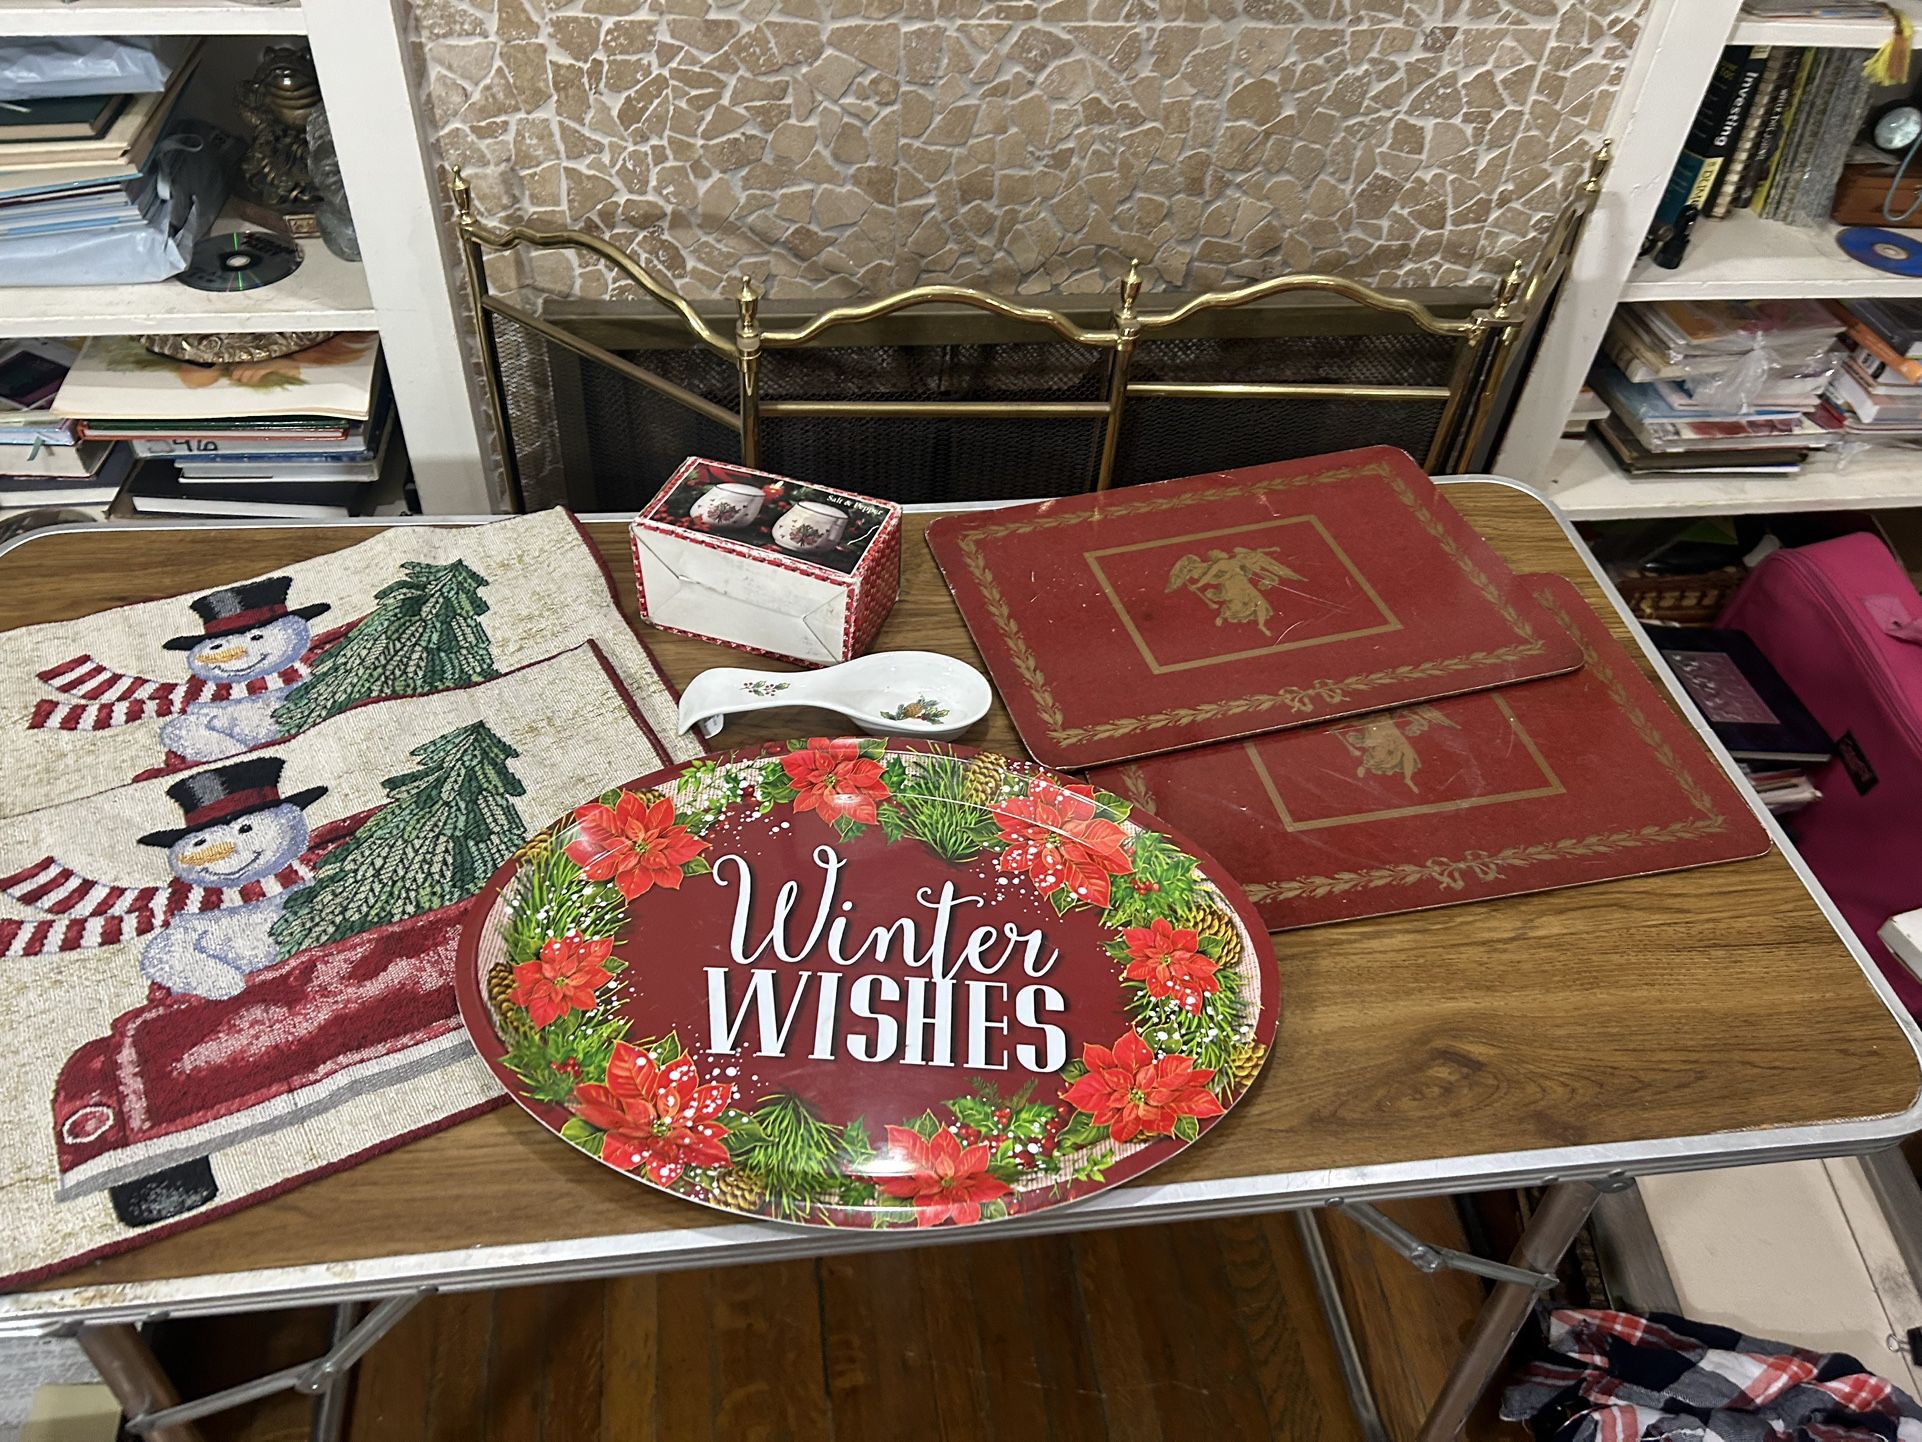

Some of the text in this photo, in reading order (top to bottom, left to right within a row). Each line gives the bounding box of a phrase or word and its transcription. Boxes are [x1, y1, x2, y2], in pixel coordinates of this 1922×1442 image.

[1714, 72, 1759, 146] Investing
[826, 494, 884, 516] Salt & Pepper
[712, 844, 1059, 981] Winter
[702, 966, 1069, 1073] WISHES
